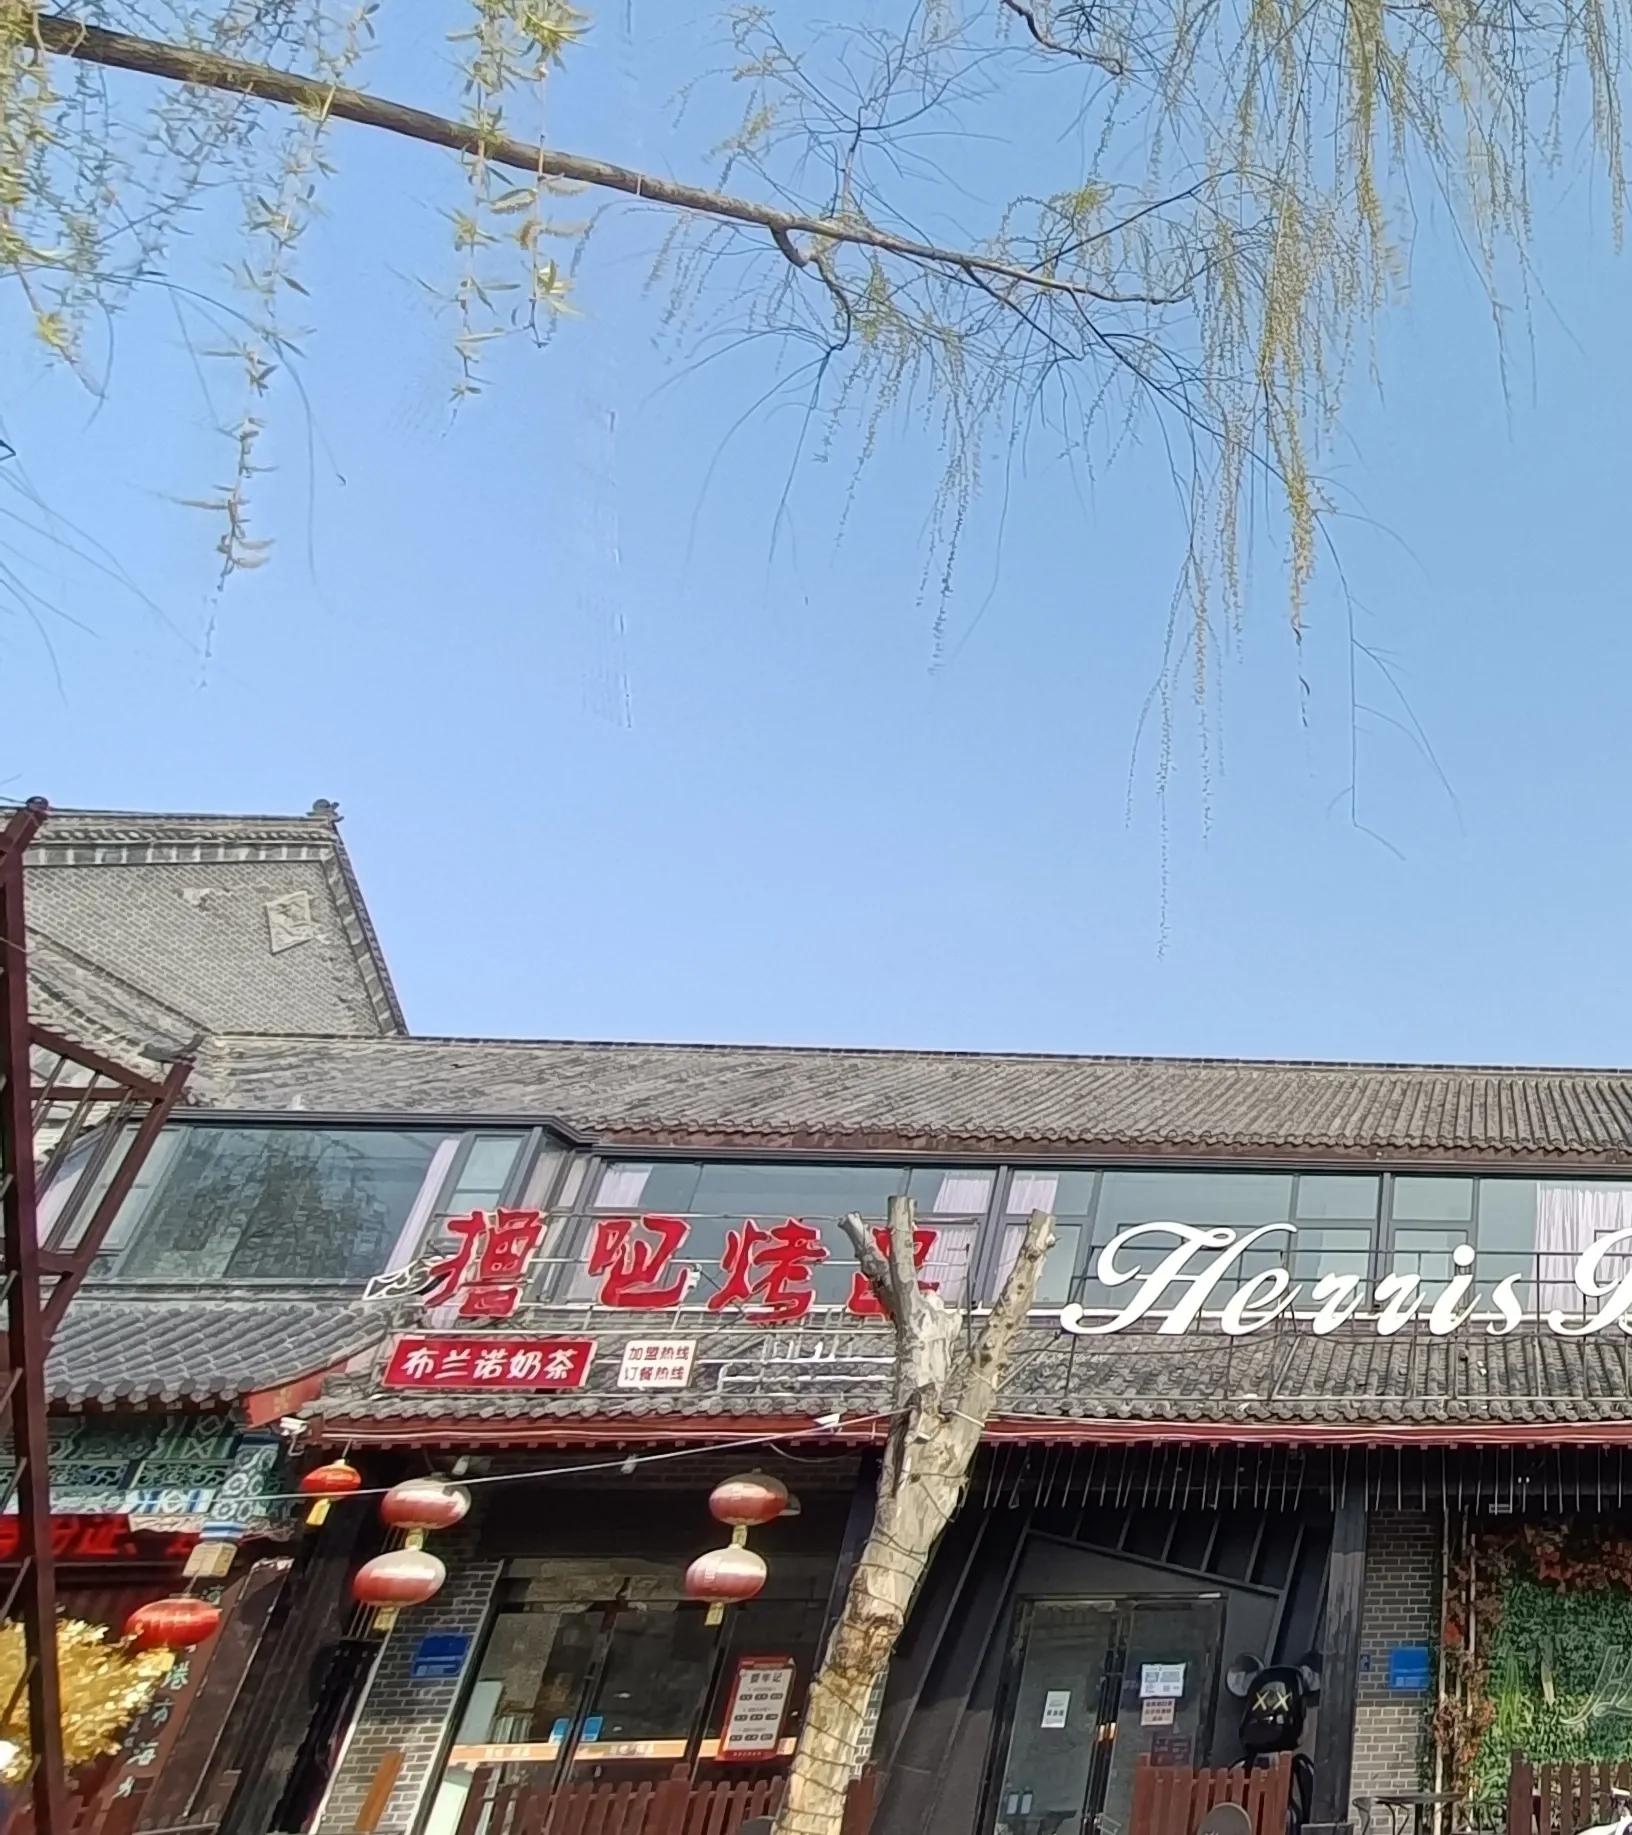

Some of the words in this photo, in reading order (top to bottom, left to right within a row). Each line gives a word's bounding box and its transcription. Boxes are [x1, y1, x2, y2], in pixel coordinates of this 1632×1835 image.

[1059, 1220, 1524, 1338] Herris
[400, 1347, 579, 1380] 布兰诺奶茶
[628, 1346, 690, 1361] 加盟热线
[624, 1366, 685, 1381] 订餐热线
